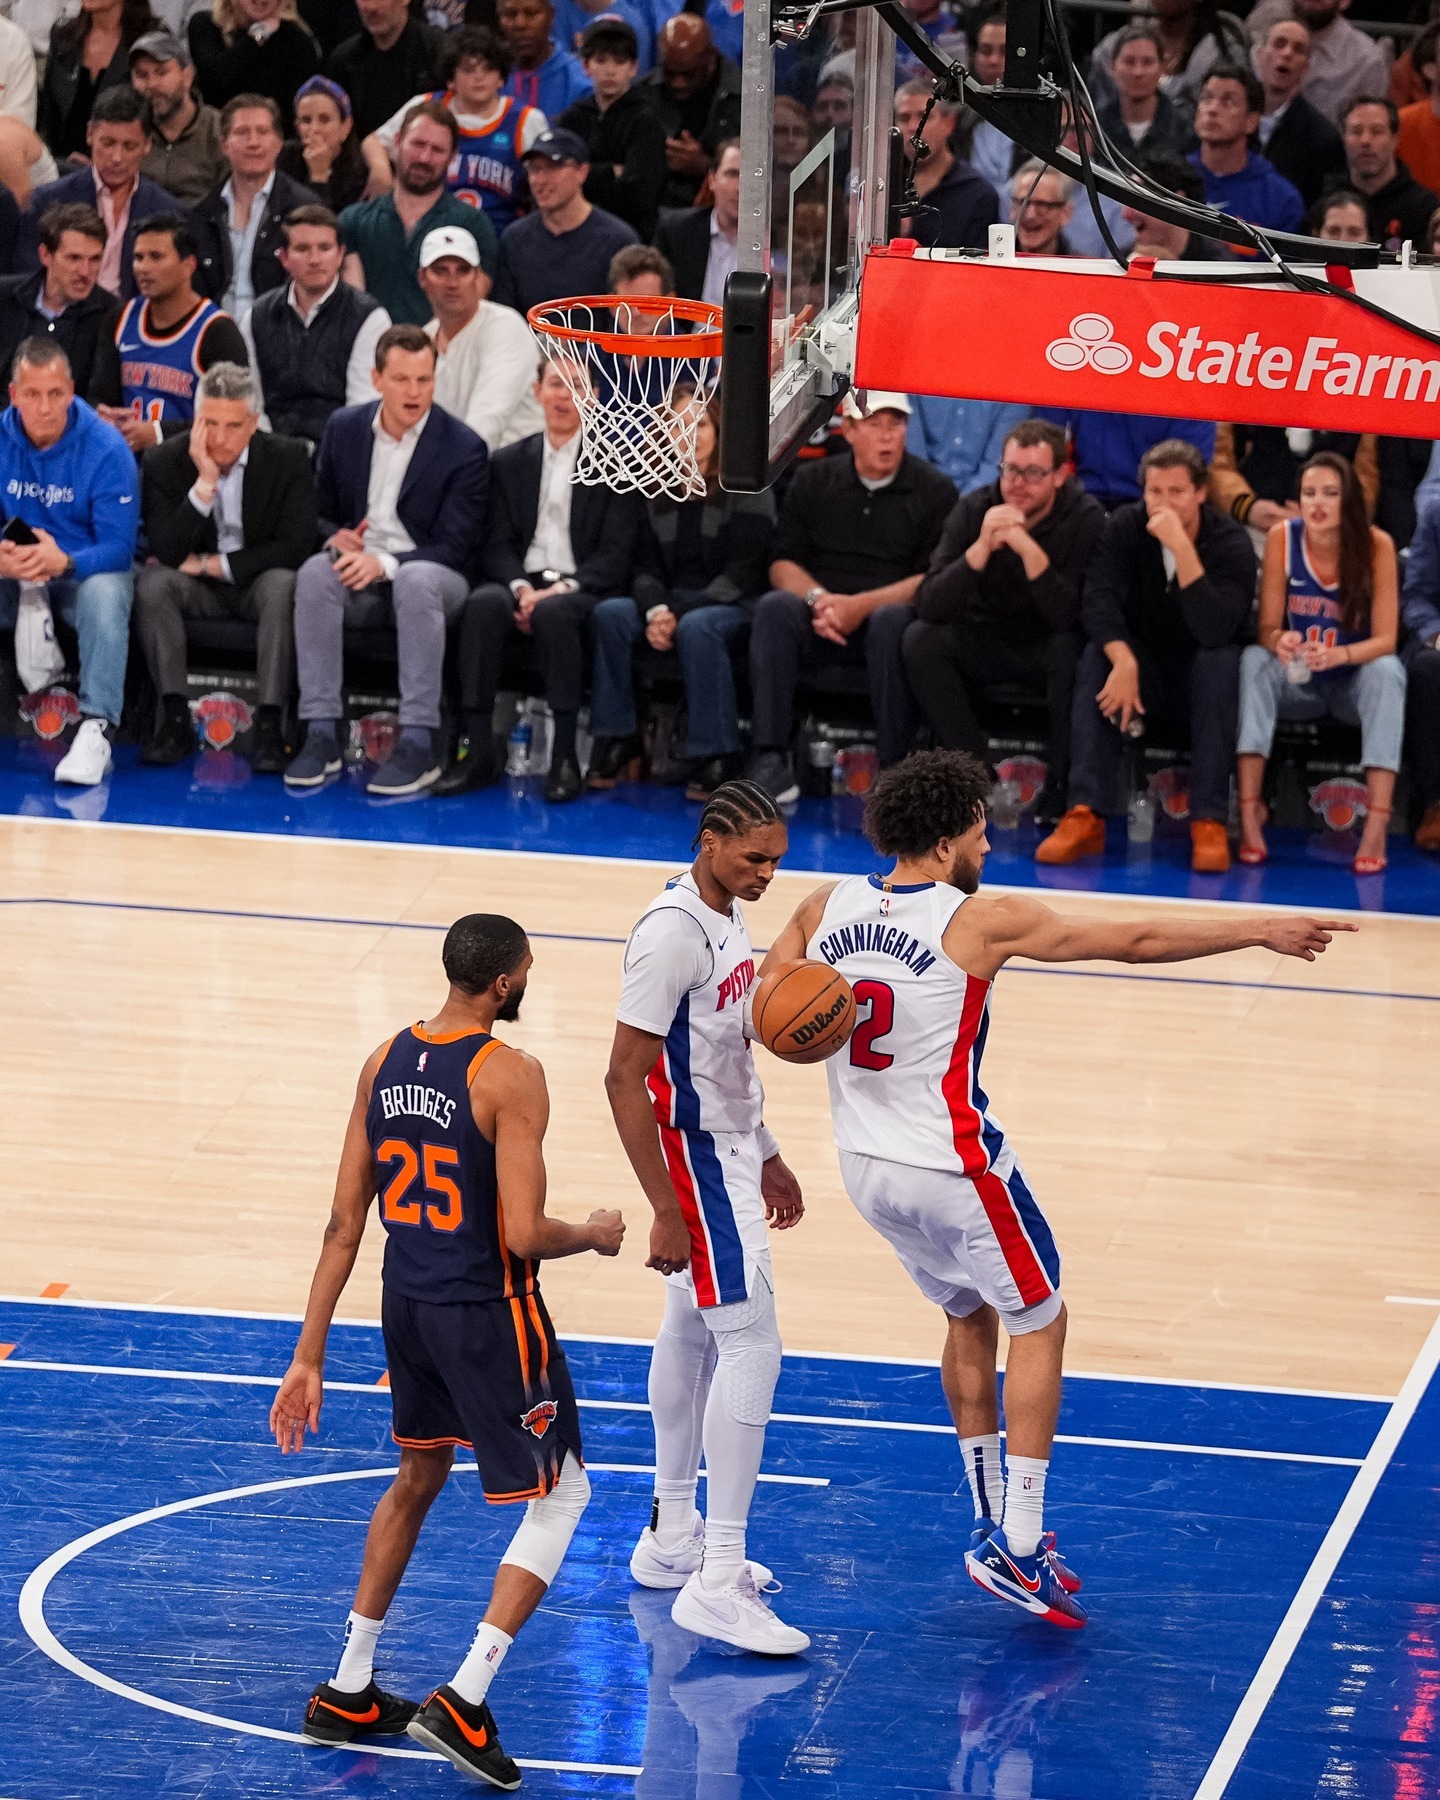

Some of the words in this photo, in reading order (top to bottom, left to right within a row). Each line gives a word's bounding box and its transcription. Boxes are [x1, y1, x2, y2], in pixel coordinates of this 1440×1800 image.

[467, 153, 514, 197] YORK
[819, 923, 937, 977] CUNNINGHAM
[788, 993, 848, 1045] Wilson
[849, 979, 895, 1072] 2
[379, 1084, 457, 1130] BRIDGES
[376, 1137, 465, 1233] 25
